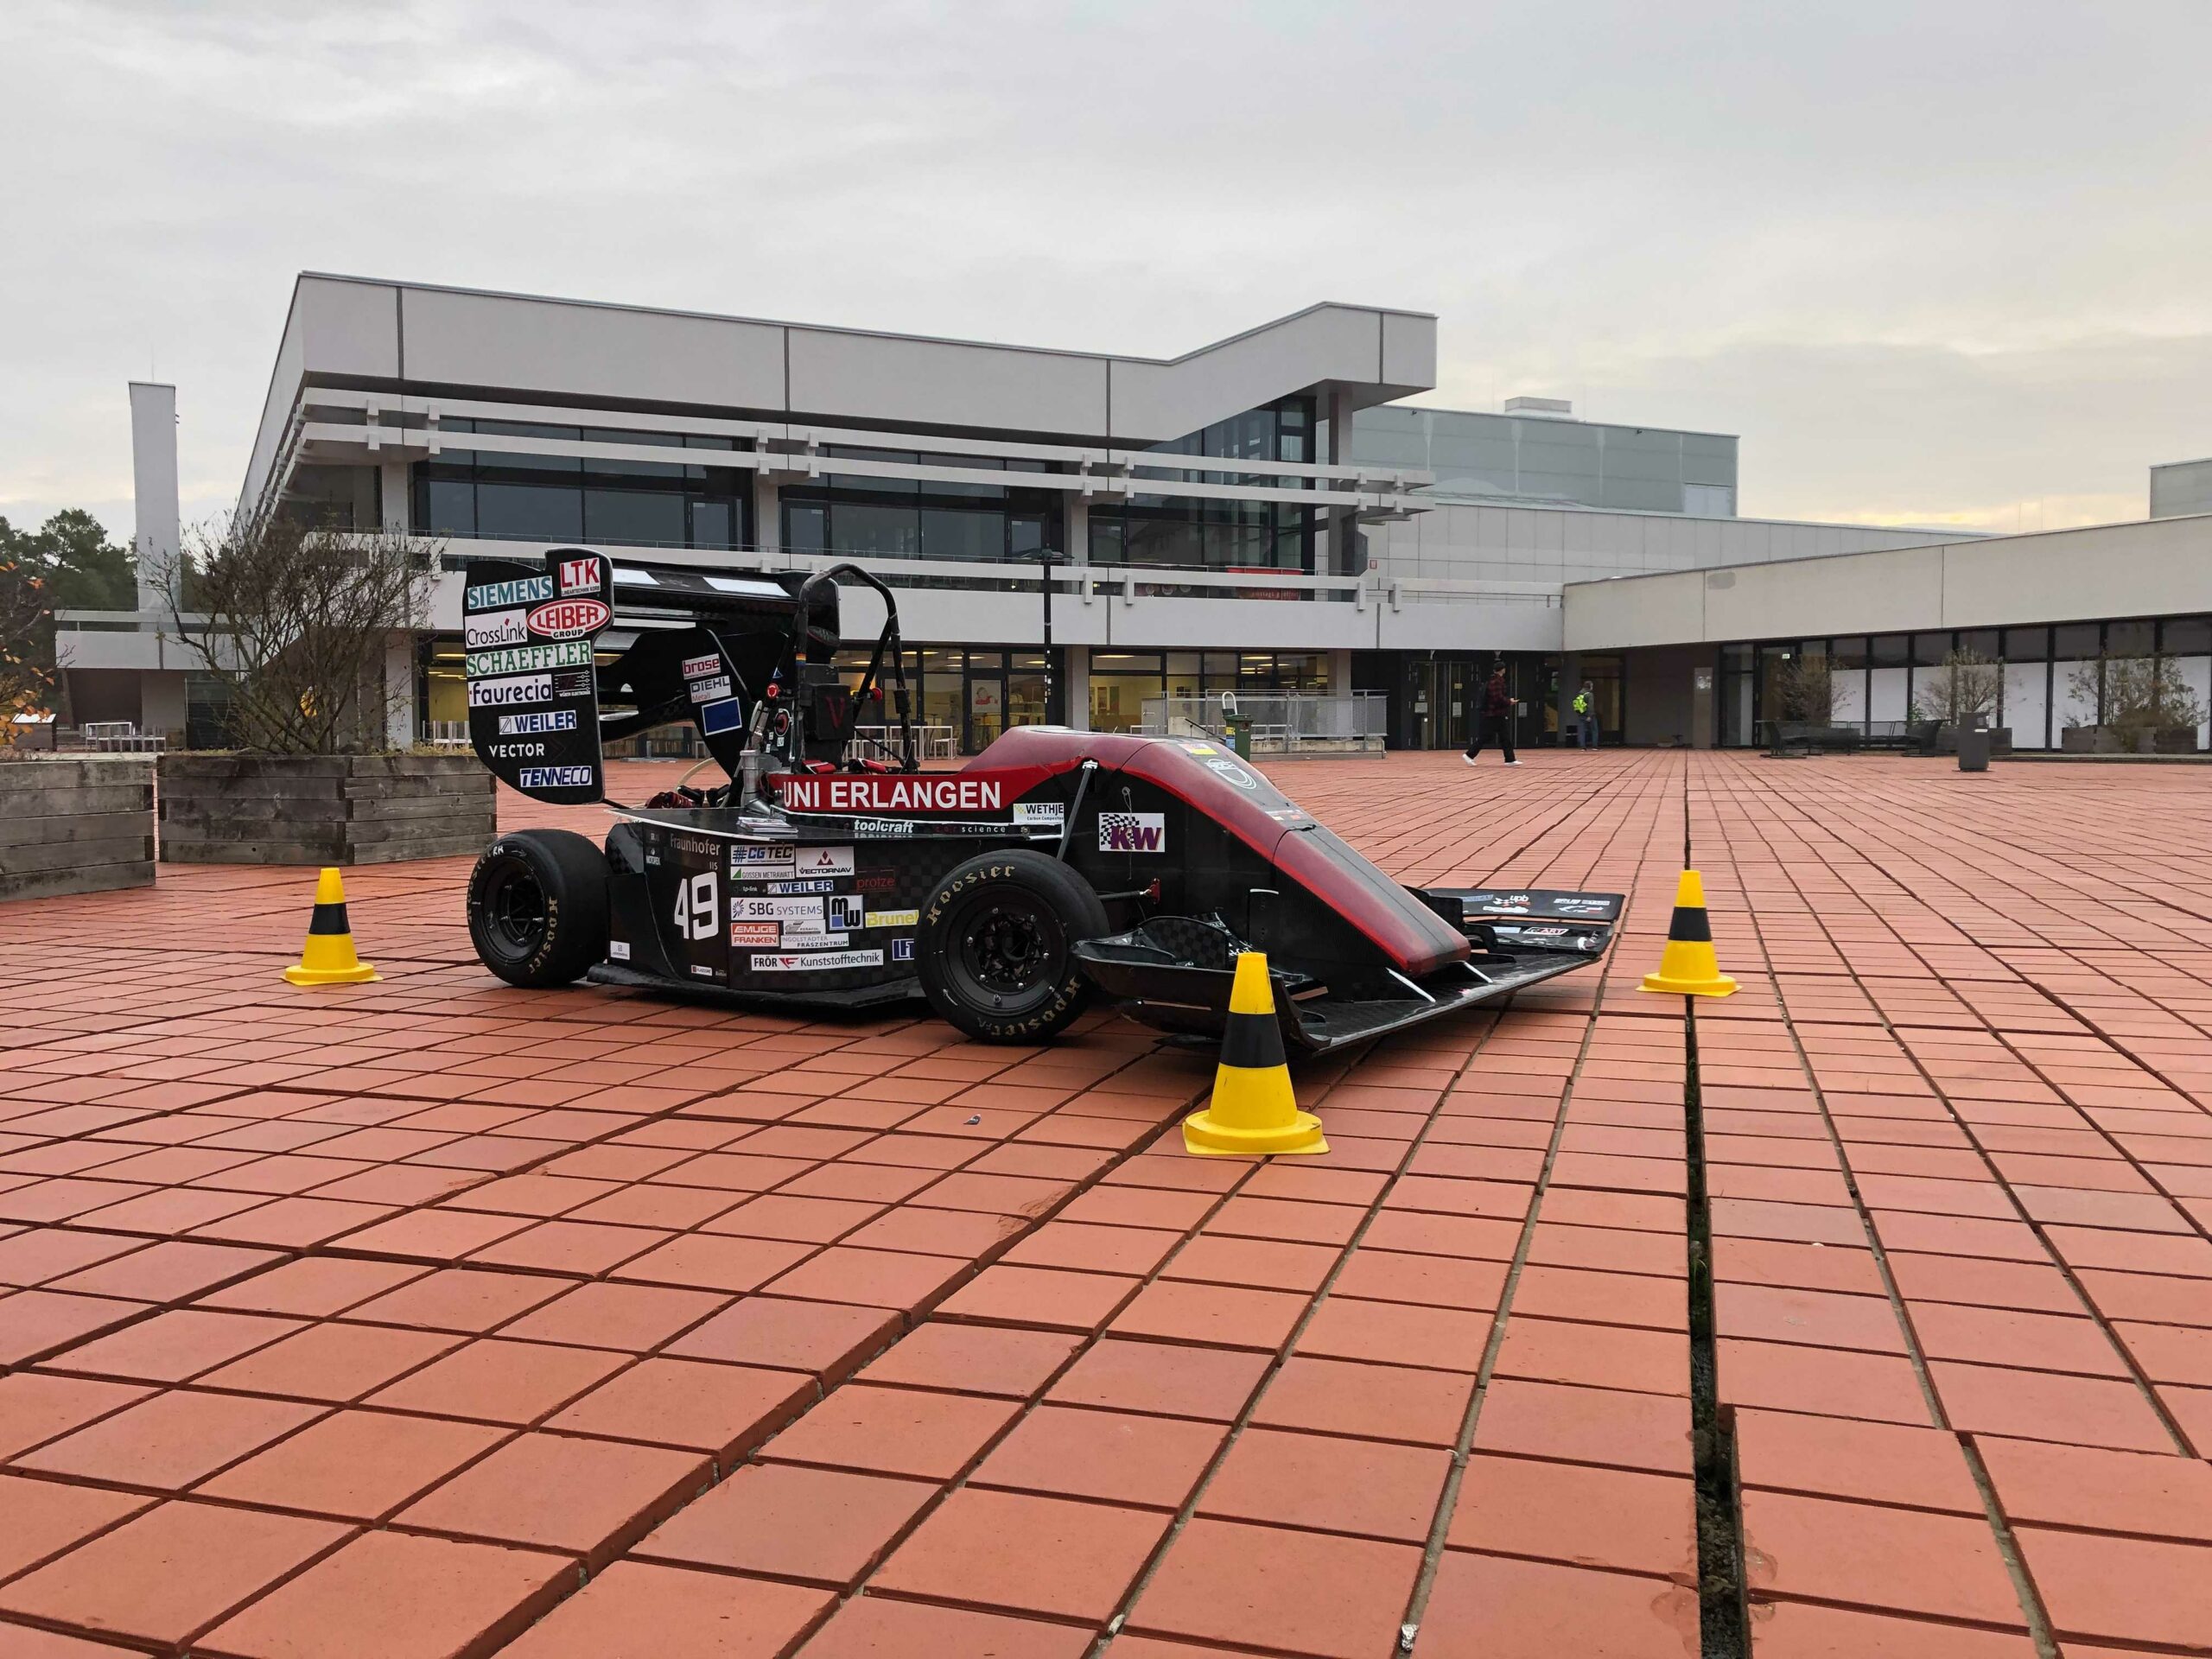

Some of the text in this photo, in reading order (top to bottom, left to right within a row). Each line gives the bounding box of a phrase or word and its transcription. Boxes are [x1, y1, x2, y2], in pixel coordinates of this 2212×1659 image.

[562, 559, 600, 588] LTK
[468, 576, 552, 608] SIEMENS
[537, 605, 599, 629] LEIBER
[467, 619, 526, 645] CrossLink
[553, 629, 583, 639] GROUP
[467, 641, 591, 676] SCHAEFFLER
[683, 658, 720, 674] brose
[473, 678, 552, 704] faurecia
[691, 677, 730, 693] DIEHL
[692, 692, 711, 702] Metall
[514, 711, 575, 733] WEILER
[489, 743, 545, 758] VECTOR
[520, 767, 591, 786] TENNECO
[784, 780, 1001, 809] UNI ERLANGEN
[1026, 804, 1064, 816] WETHJE
[854, 820, 913, 834] toolcraft
[1110, 825, 1162, 850] KW
[670, 833, 721, 856] Fraunhofer
[779, 881, 833, 893] WEILER
[925, 864, 1016, 926] Hoosier
[674, 871, 719, 941] 49
[748, 902, 823, 916] SBG SYSTEMS
[754, 952, 880, 967] FRÖR Kunststofftechnik
